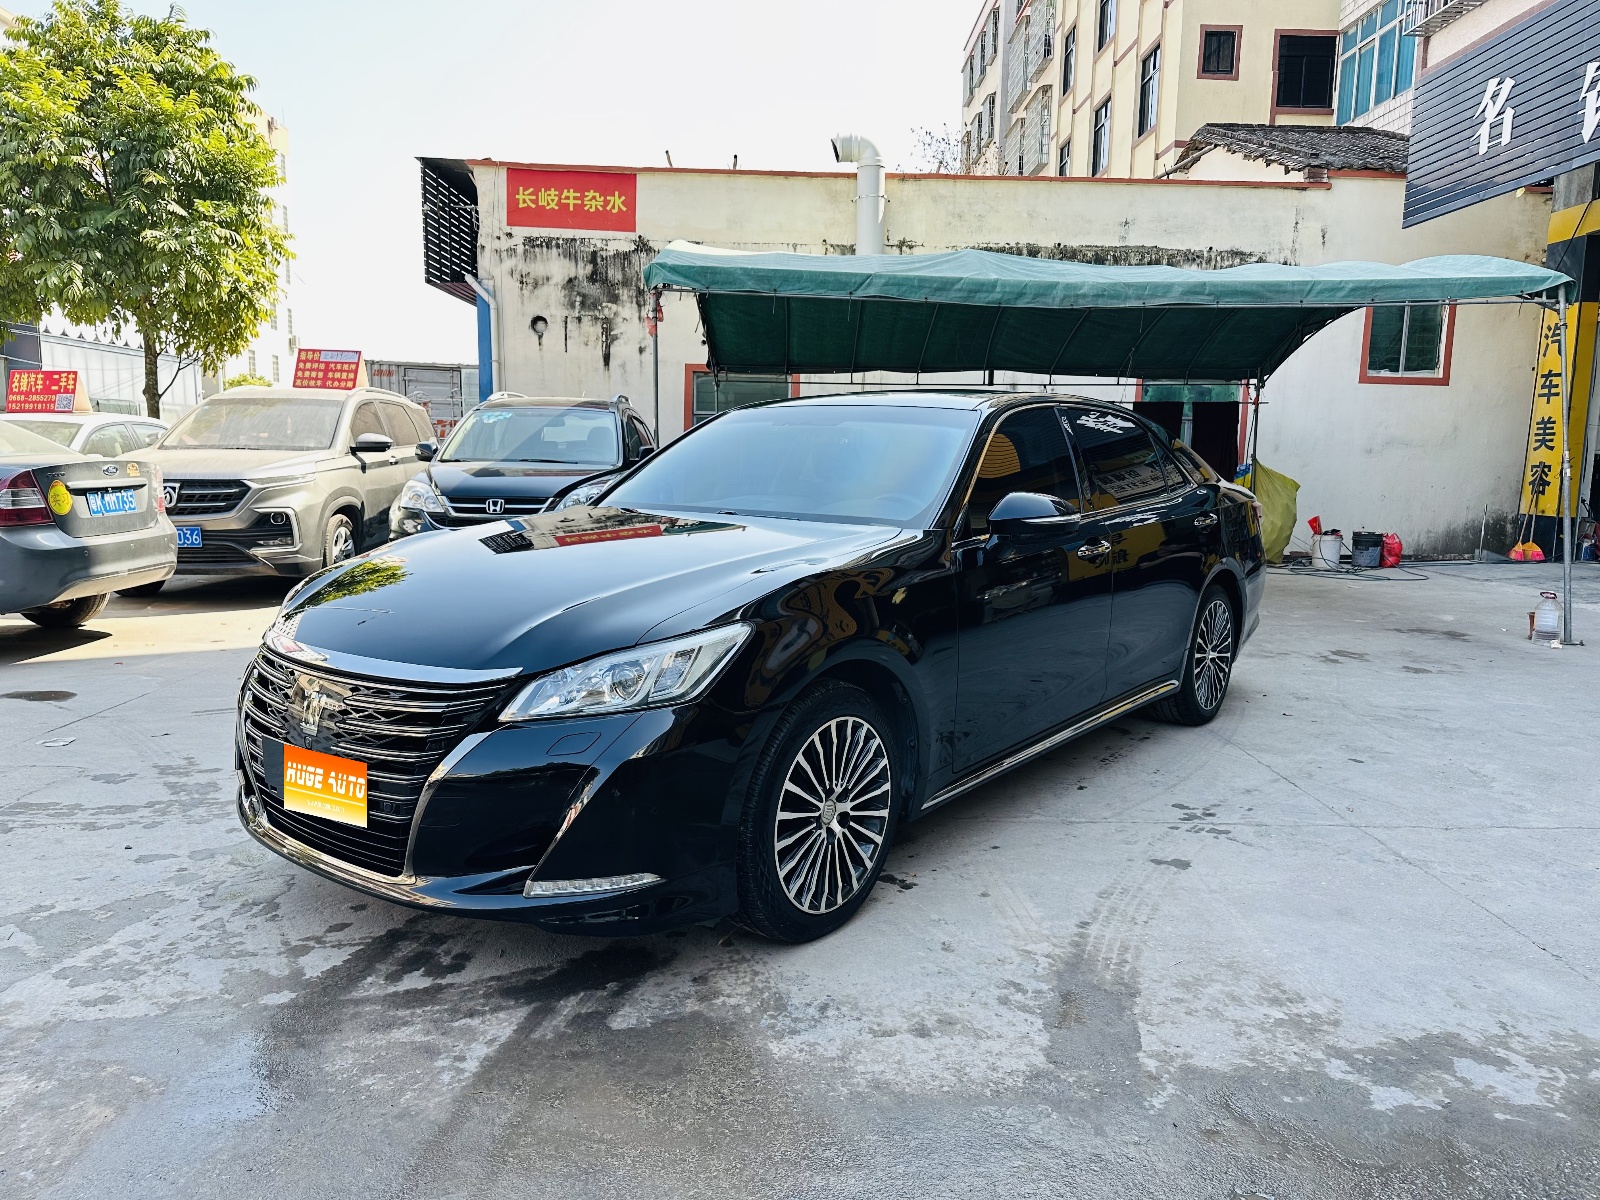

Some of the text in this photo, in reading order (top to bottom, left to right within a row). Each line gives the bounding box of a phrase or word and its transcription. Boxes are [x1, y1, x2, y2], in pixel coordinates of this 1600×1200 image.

[516, 187, 627, 213] 长岐牛杂水
[8, 394, 56, 402] 0668-2855279
[1528, 323, 1568, 496] 汽车美容
[50, 492, 69, 508] 实习
